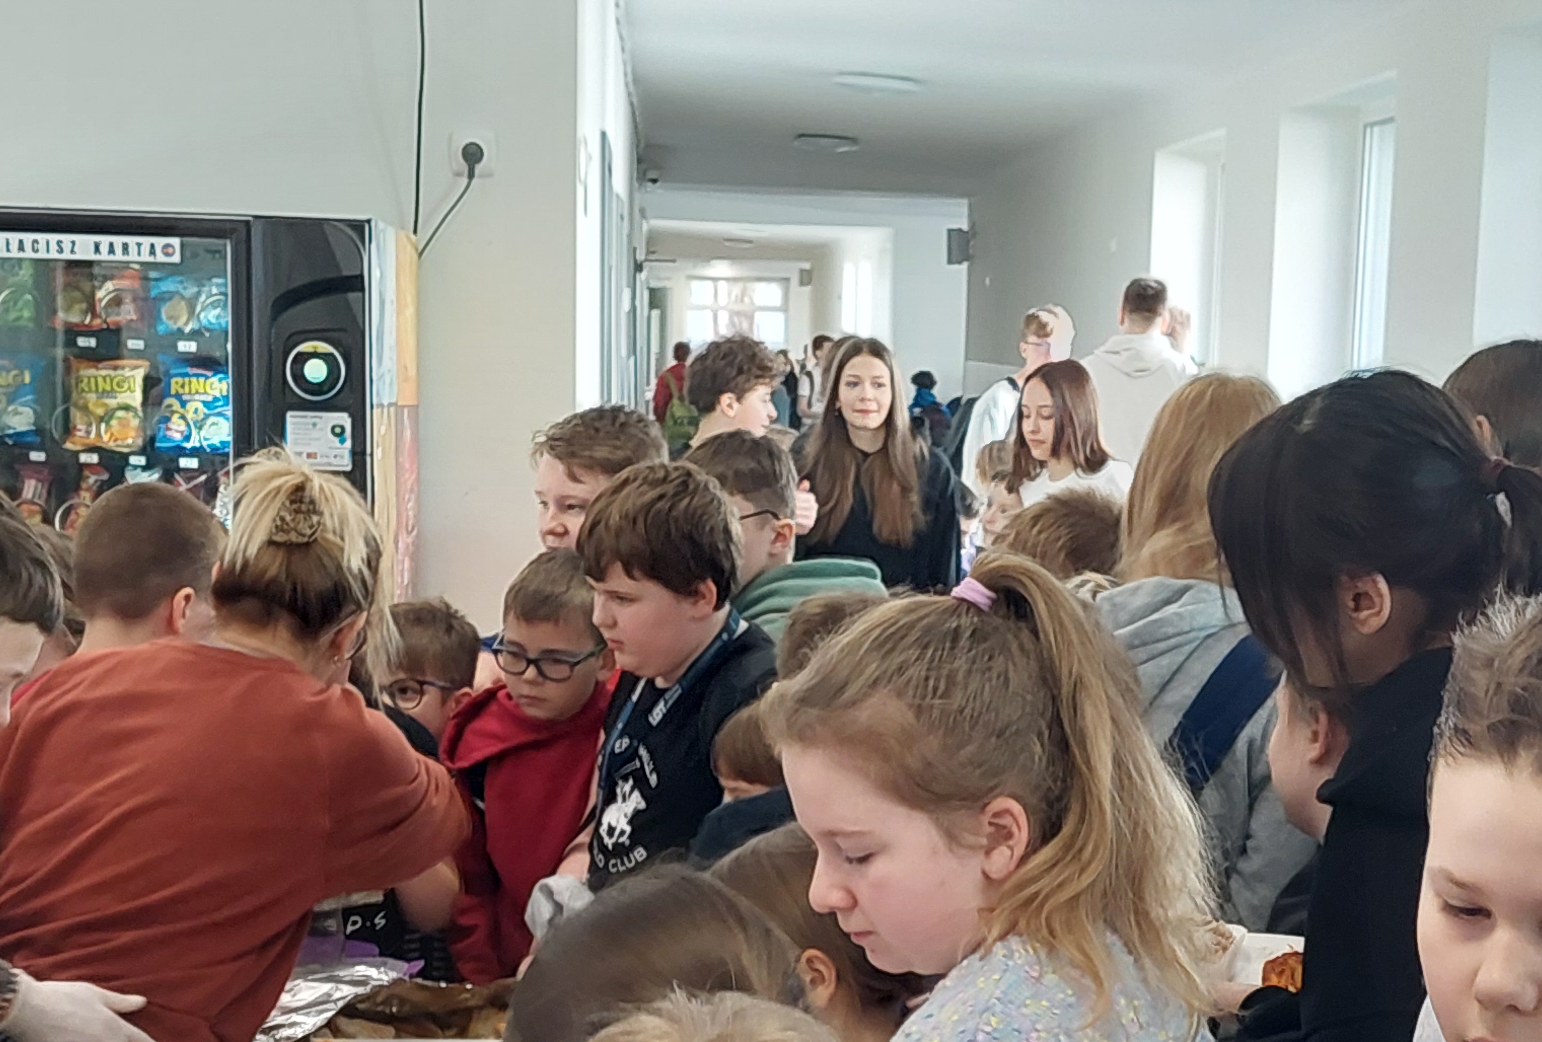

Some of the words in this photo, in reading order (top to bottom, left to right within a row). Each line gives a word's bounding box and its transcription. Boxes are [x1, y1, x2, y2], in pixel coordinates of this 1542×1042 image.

[92, 240, 158, 260] KARTĄ
[76, 374, 136, 394] RINGI
[608, 845, 647, 874] CLUB
